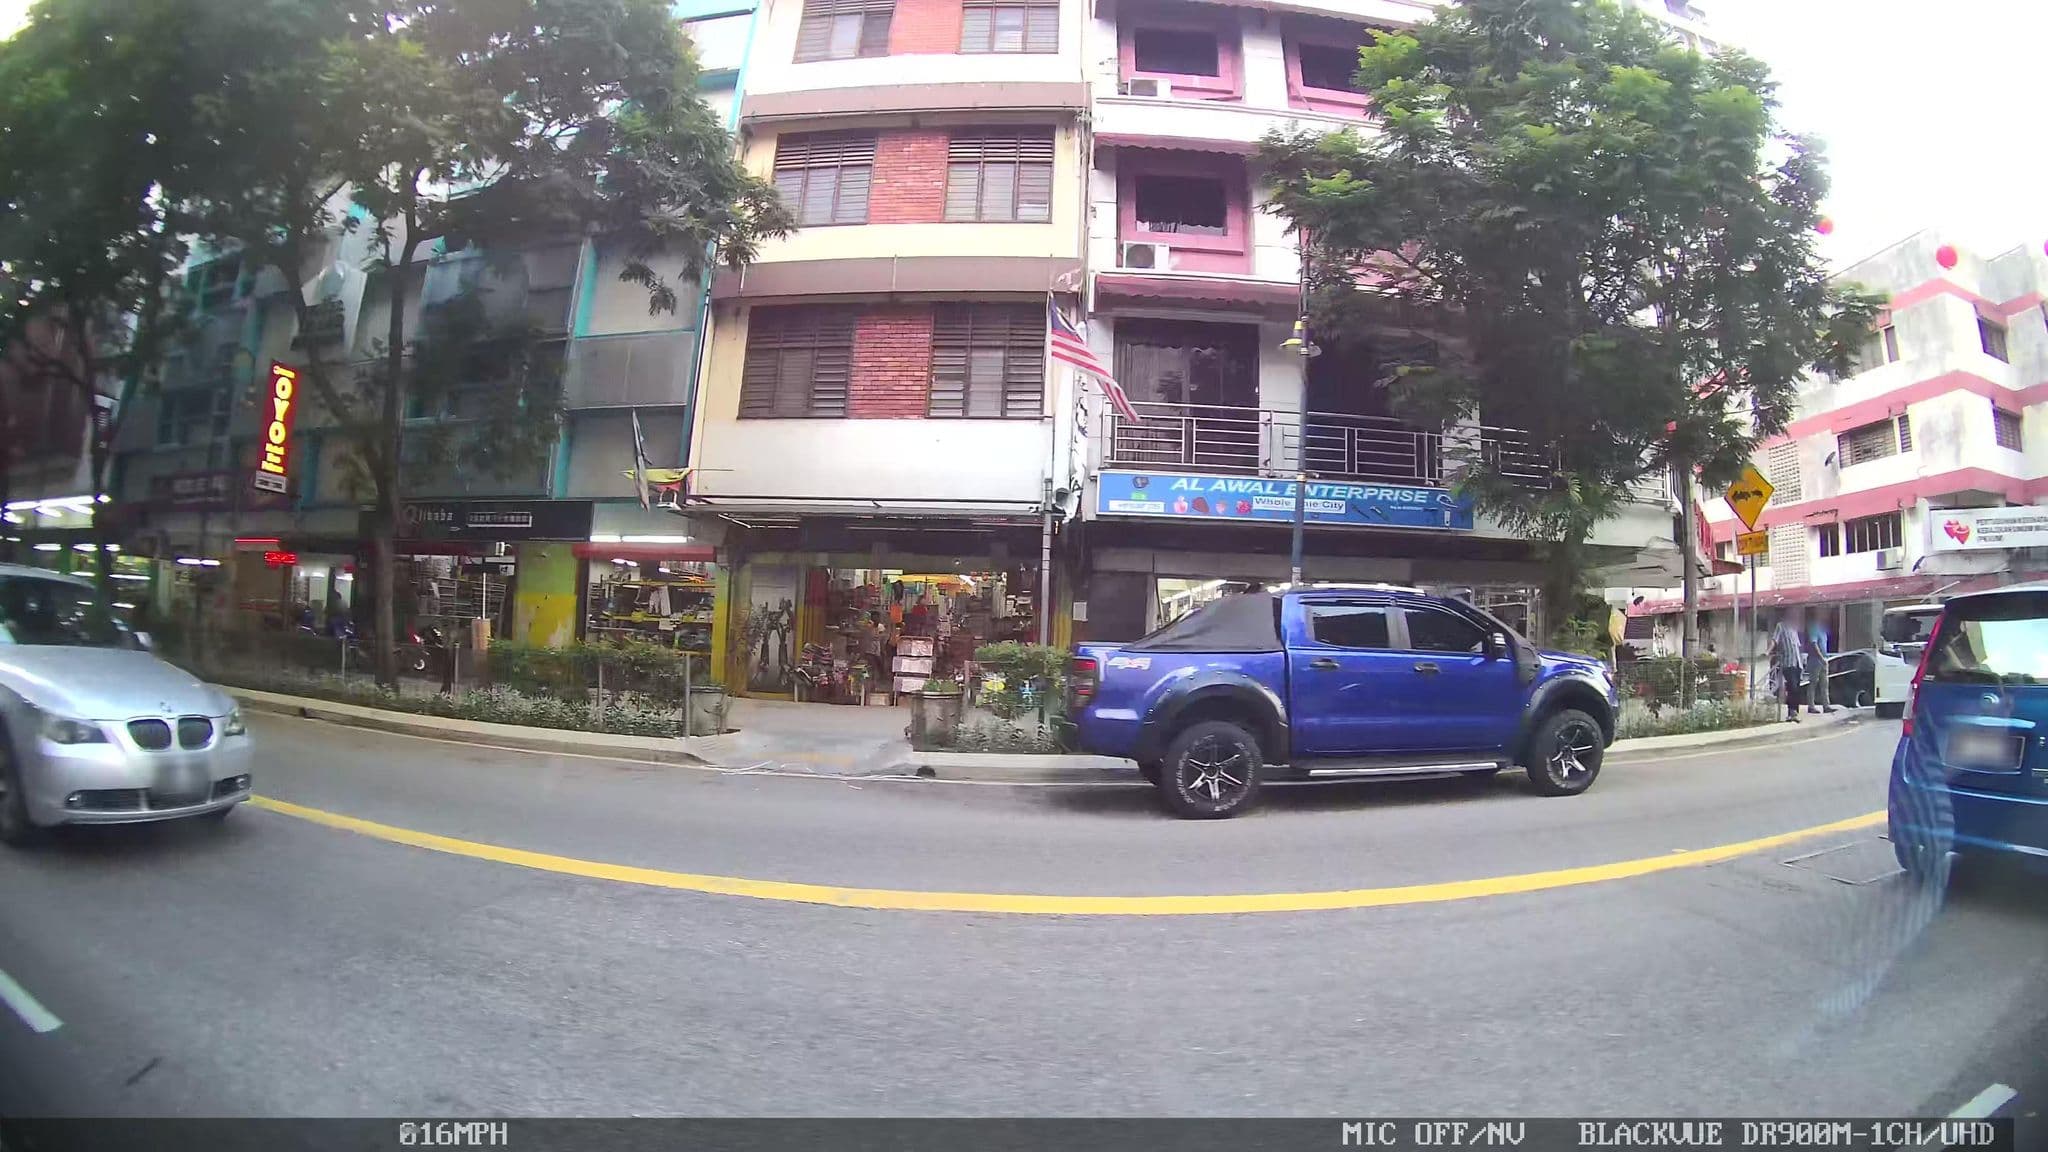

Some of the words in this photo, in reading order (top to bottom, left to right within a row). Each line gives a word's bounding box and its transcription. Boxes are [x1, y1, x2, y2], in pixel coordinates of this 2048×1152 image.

[1169, 478, 1205, 491] AL
[1208, 480, 1279, 496] AWAL
[1284, 483, 1429, 503] ENTERPRISE
[1322, 500, 1344, 511] City
